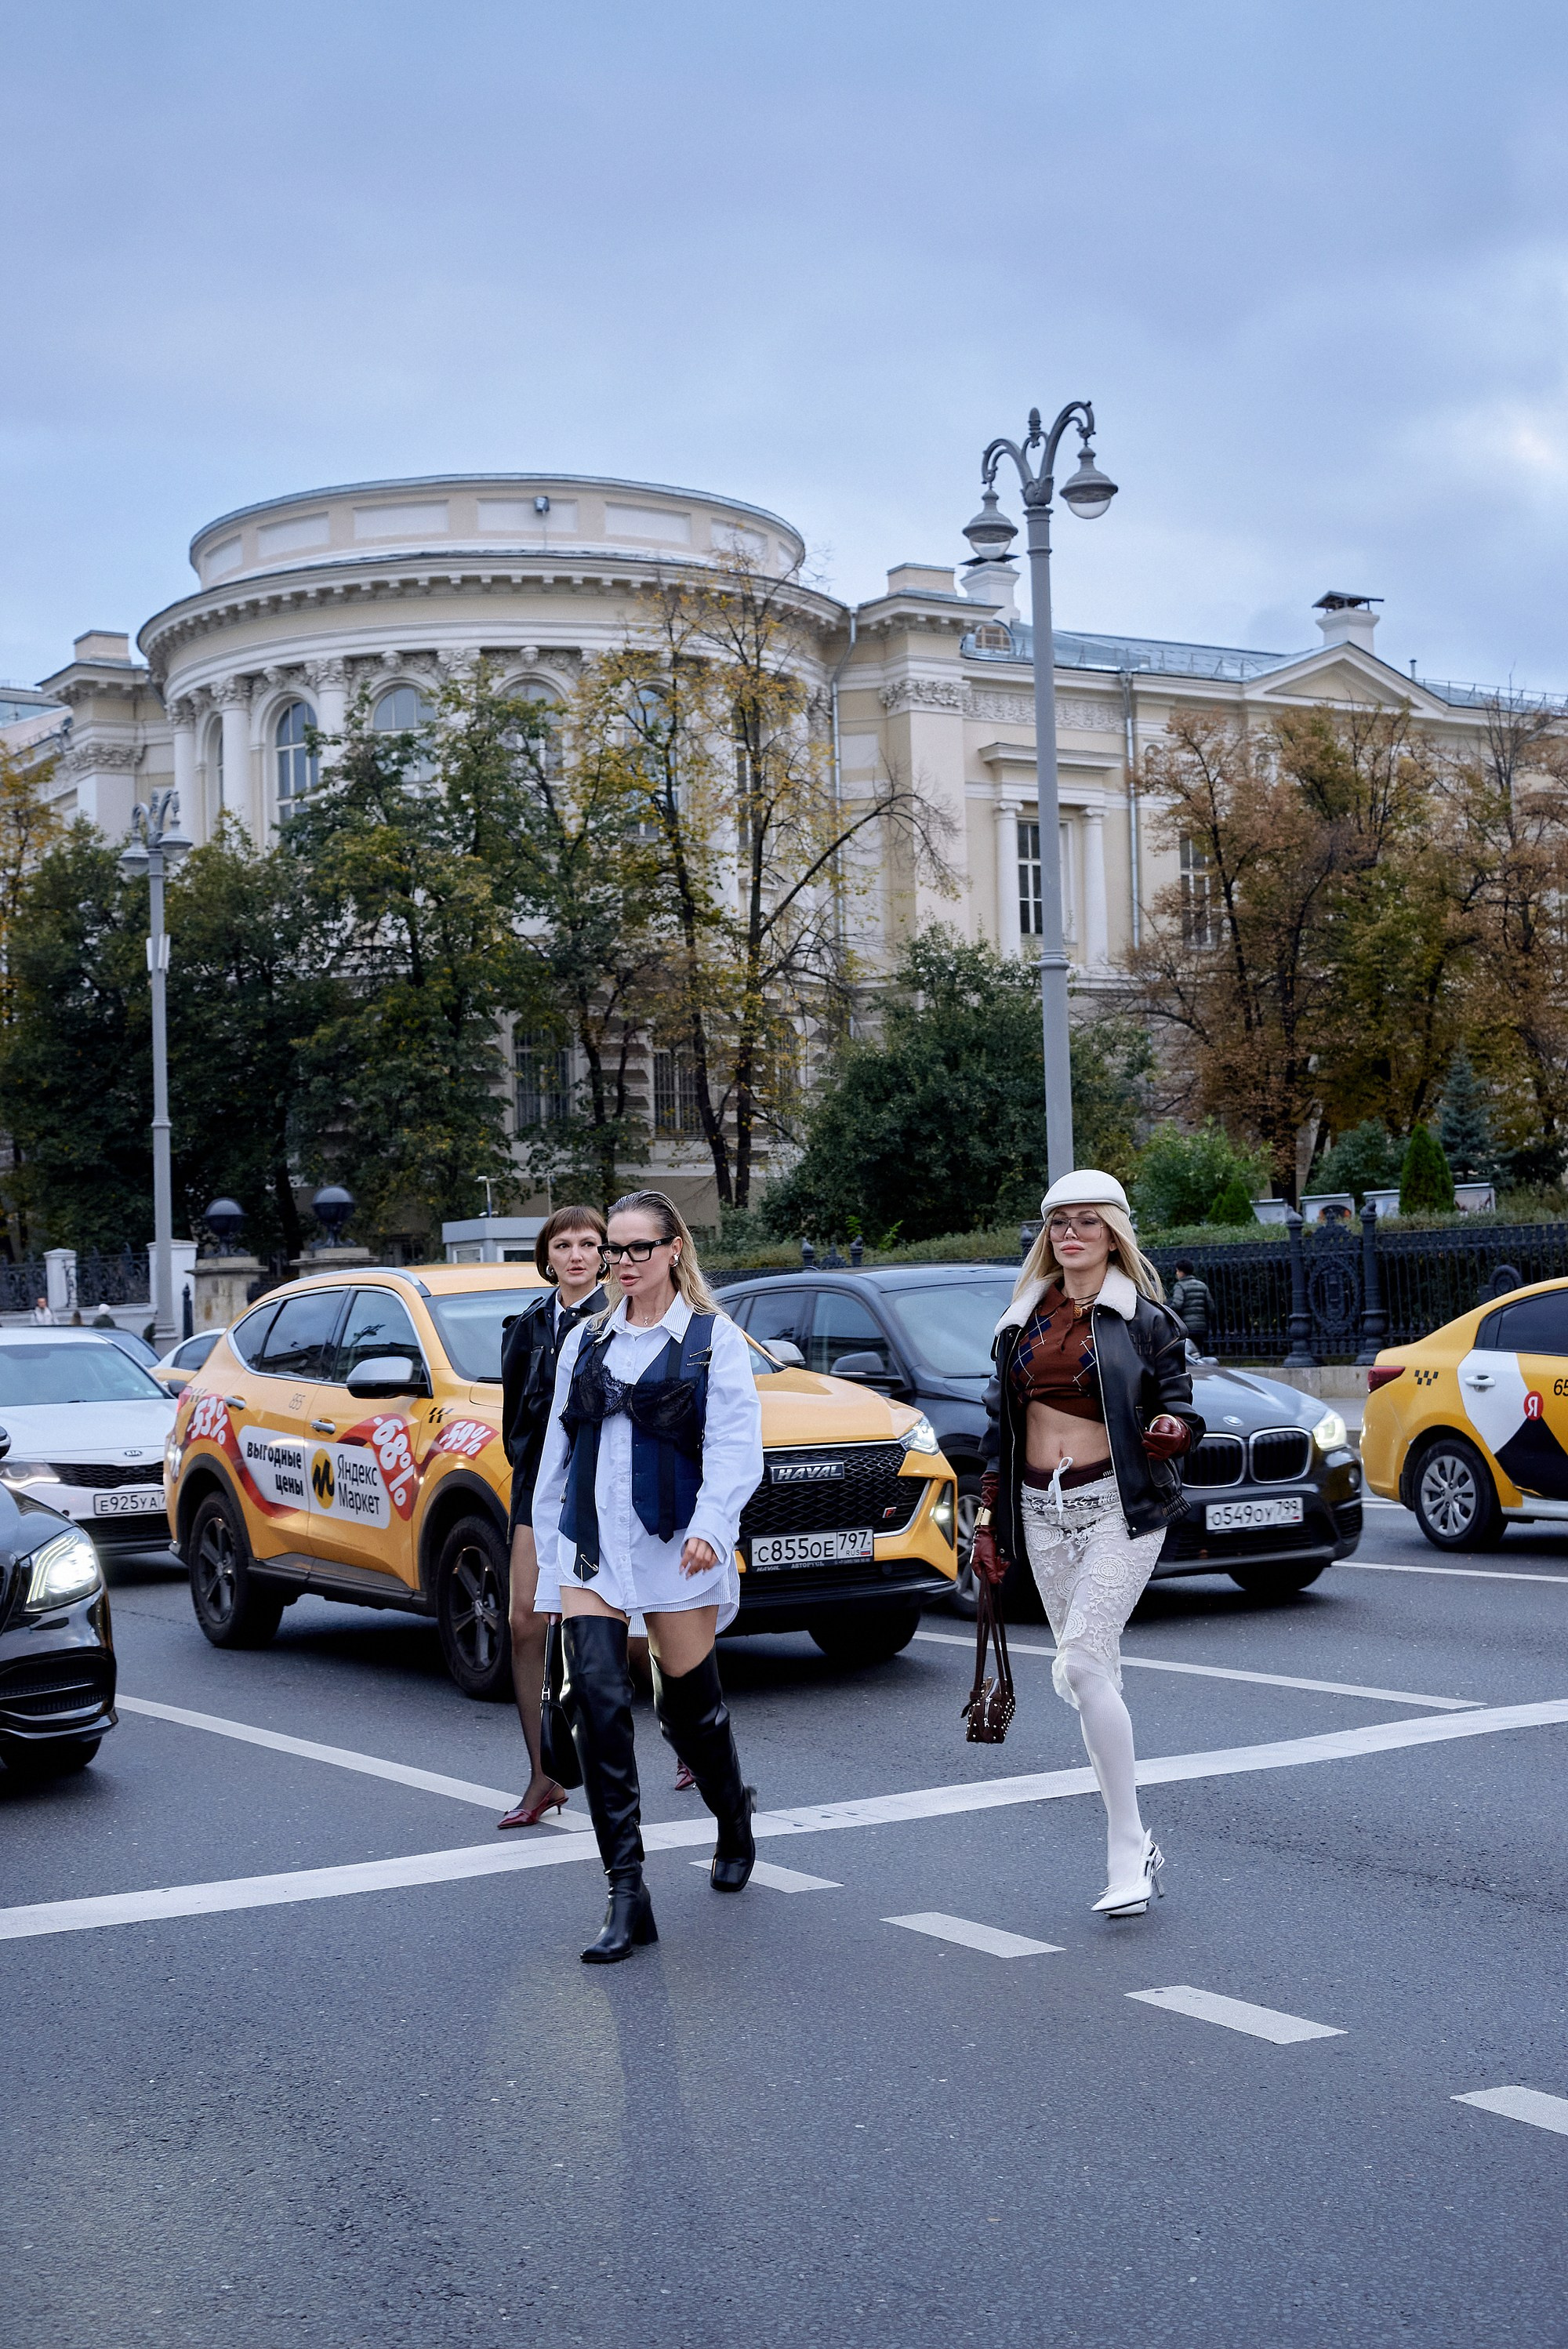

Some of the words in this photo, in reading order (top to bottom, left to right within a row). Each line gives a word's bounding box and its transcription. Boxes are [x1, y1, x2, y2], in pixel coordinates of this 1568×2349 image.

[187, 1396, 228, 1445] -53%
[1528, 1396, 1539, 1417] Я
[439, 1421, 492, 1456] -59%
[247, 1442, 302, 1469] выгодные
[372, 1417, 414, 1507] -68%
[275, 1474, 303, 1496] цены
[337, 1454, 378, 1487] Яндекс
[777, 1465, 841, 1480] HAVAL
[338, 1483, 380, 1515] Маркет
[839, 1531, 868, 1550] 797
